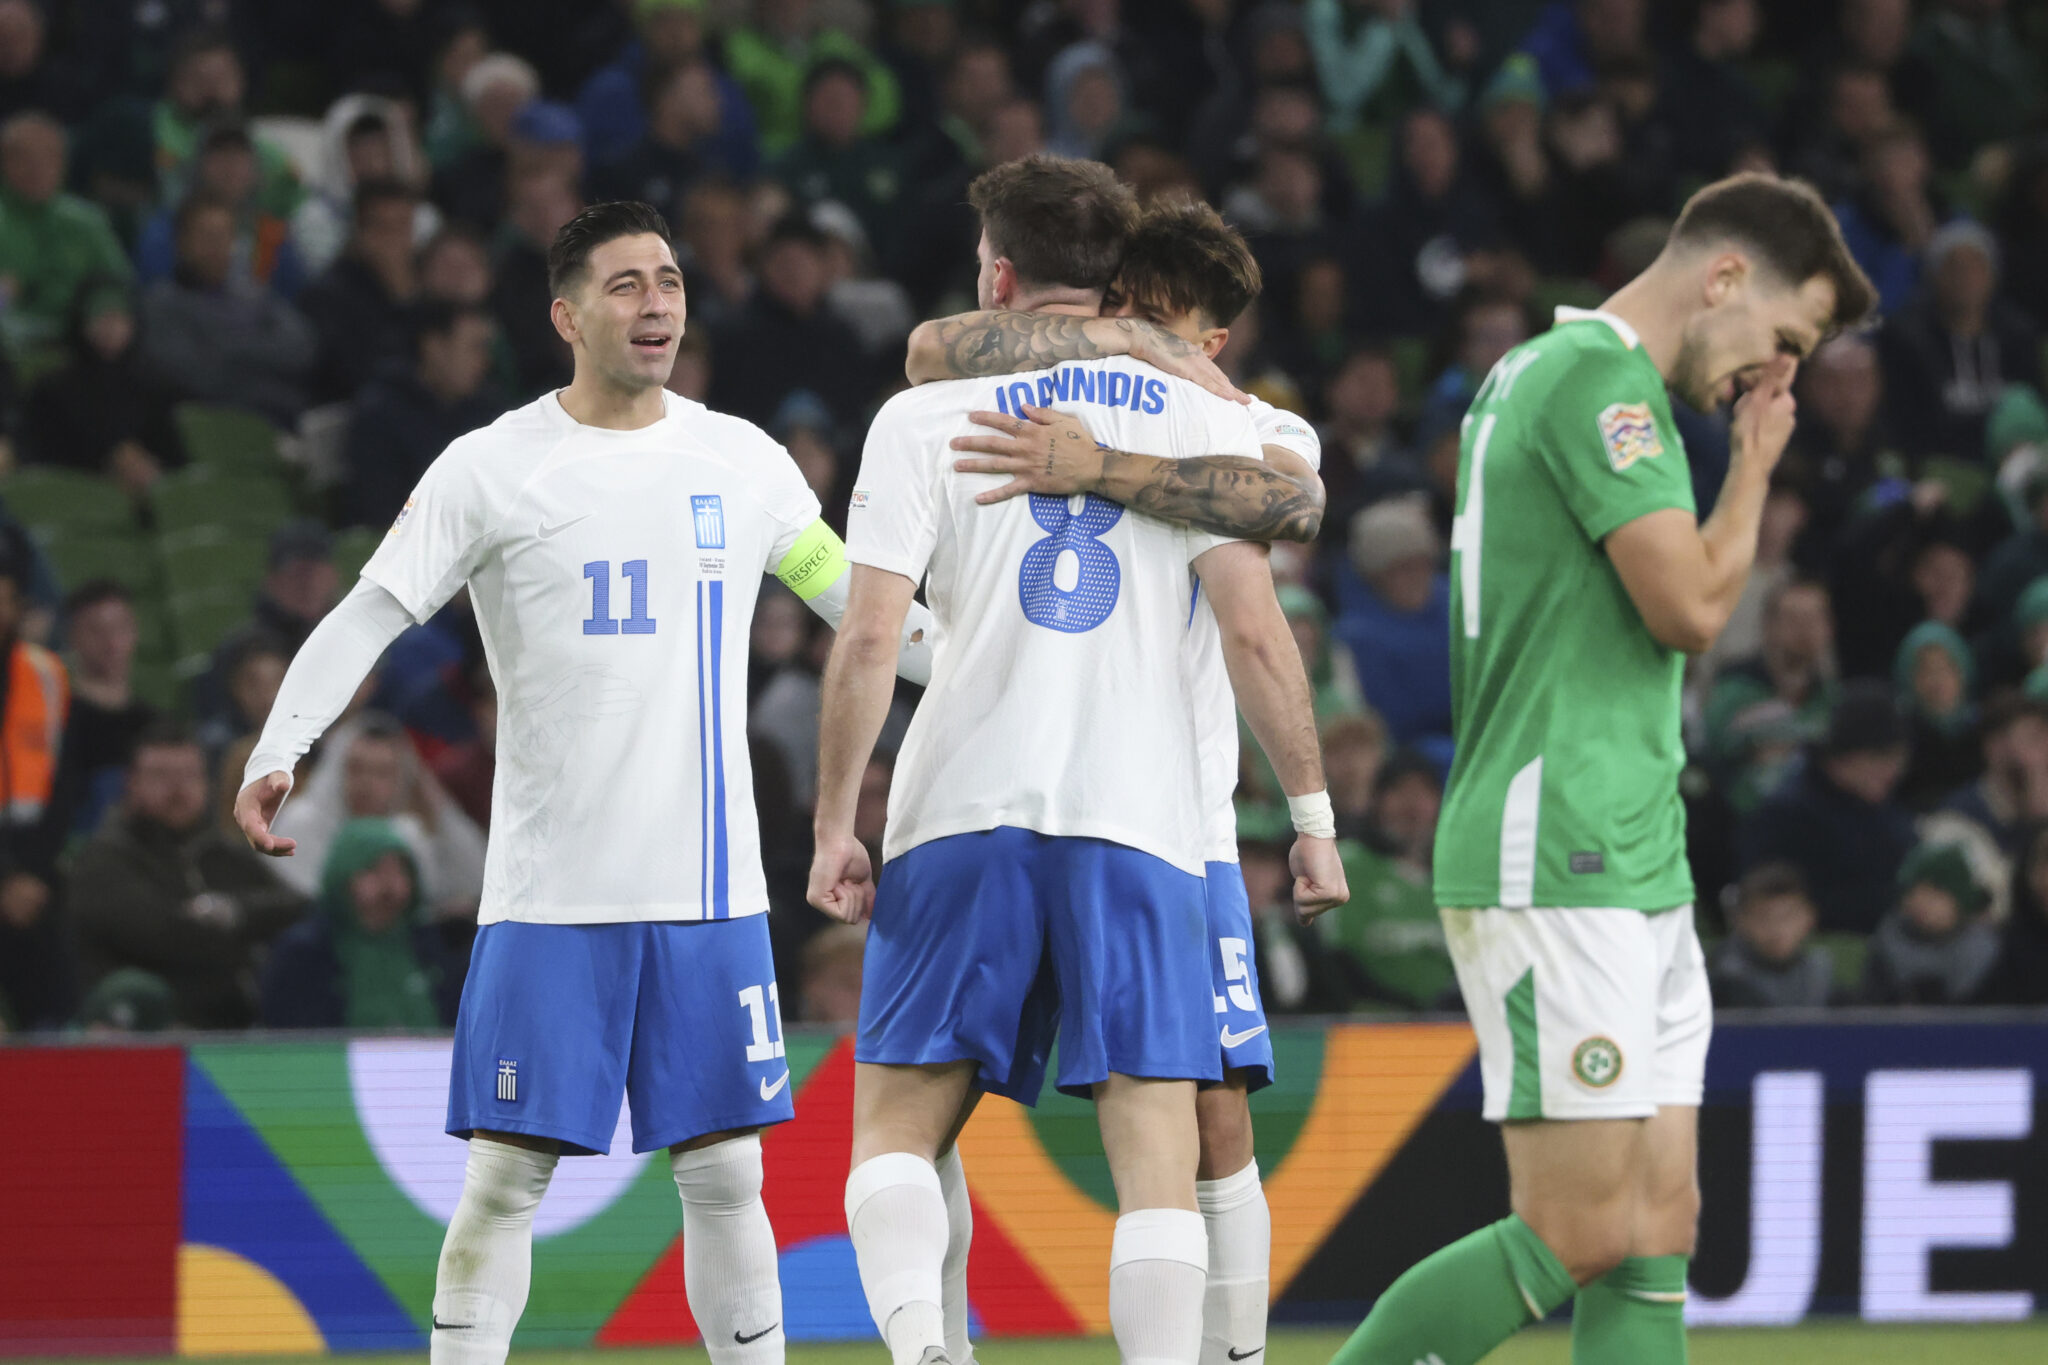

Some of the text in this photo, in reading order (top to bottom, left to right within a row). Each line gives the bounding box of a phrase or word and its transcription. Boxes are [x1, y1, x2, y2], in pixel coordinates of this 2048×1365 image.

[583, 559, 656, 635] 11
[788, 543, 829, 584] RESPECT
[1018, 491, 1126, 634] 8
[1213, 937, 1257, 1014] 5
[738, 981, 785, 1062] 11
